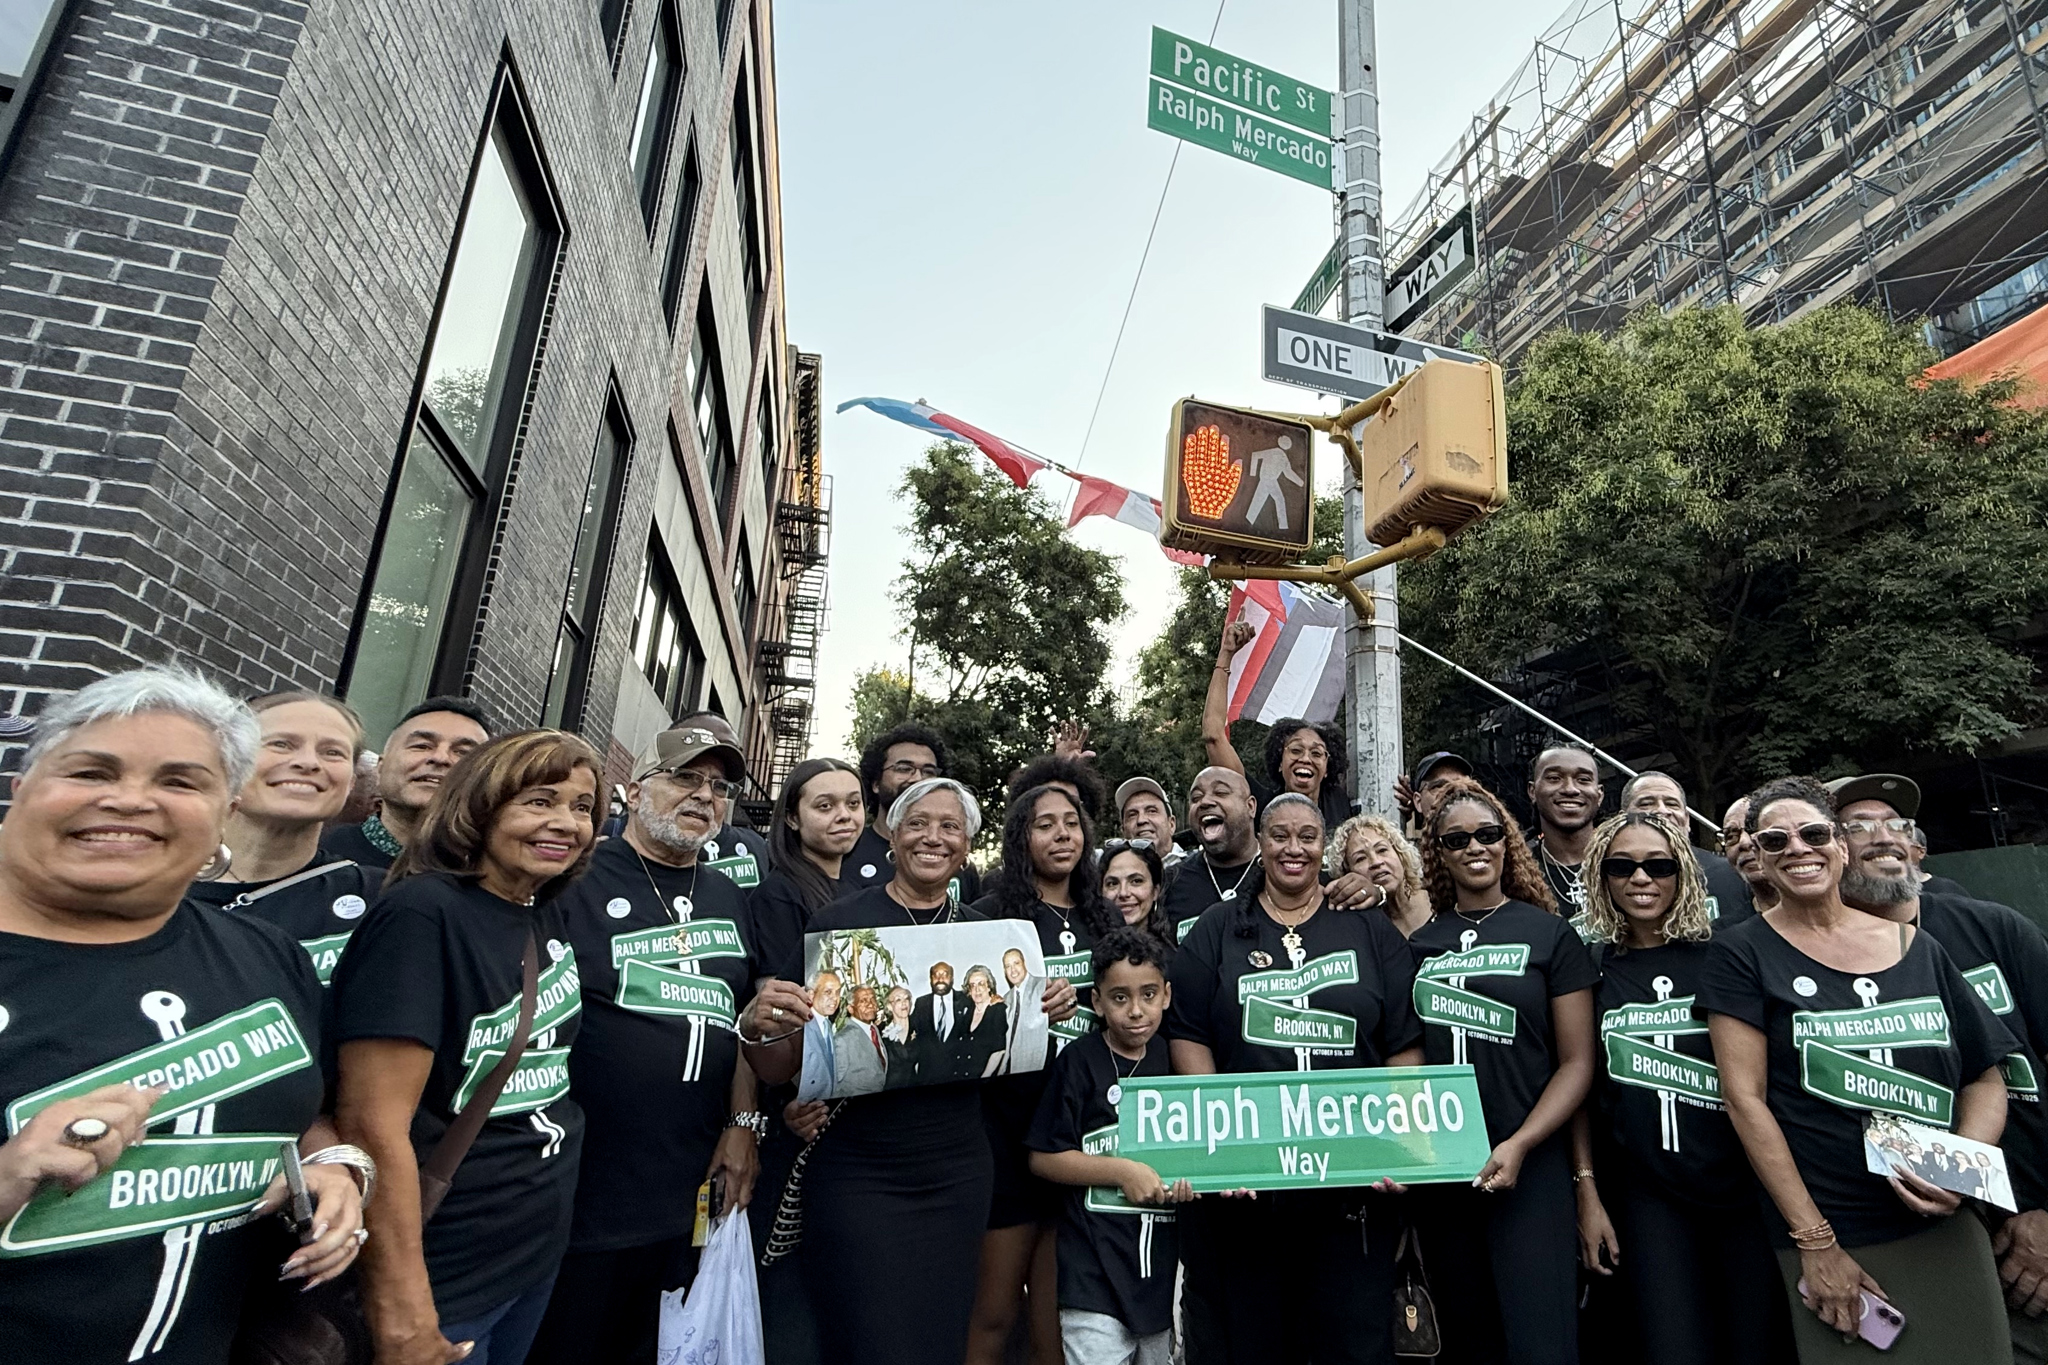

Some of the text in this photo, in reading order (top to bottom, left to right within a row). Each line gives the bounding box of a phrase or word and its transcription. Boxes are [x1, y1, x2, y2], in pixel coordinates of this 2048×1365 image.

[1174, 41, 1315, 112] Pacific St
[1158, 86, 1327, 168] Ralph Mercado
[1231, 139, 1259, 162] Way
[1405, 239, 1454, 304] WAY
[1290, 336, 1353, 375] ONE
[734, 863, 754, 878] WAY
[615, 929, 736, 958] RALPH MERADO WAY
[1047, 961, 1089, 978] MERCADO
[1432, 954, 1485, 971] MERCADO
[1488, 952, 1521, 966] WAY
[1241, 960, 1351, 995] RALPH MERCADO WAY
[660, 980, 724, 1011] BROOKLYN,
[1431, 994, 1501, 1026] BROOKLYN, NY
[1274, 1016, 1343, 1040] BROOKLYN, NY
[1628, 1007, 1690, 1026] MERCADO
[1796, 1011, 1944, 1037] RALPH MERCADO WAY
[242, 1019, 295, 1058] WAY
[471, 1020, 514, 1049] RALPH
[1467, 1030, 1489, 1041] OCTOBER
[1632, 1053, 1719, 1092] BROOKLYN, NY
[1678, 1095, 1705, 1108] OCTOBER
[1844, 1069, 1938, 1113] BROOKLYN, NY
[2021, 1093, 2040, 1103] 2025
[1136, 1078, 1465, 1156] Ralph Mercado
[1085, 1138, 1112, 1156] RALPH
[1277, 1145, 1331, 1182] Way
[109, 1157, 279, 1209] BROOKLYN, NY
